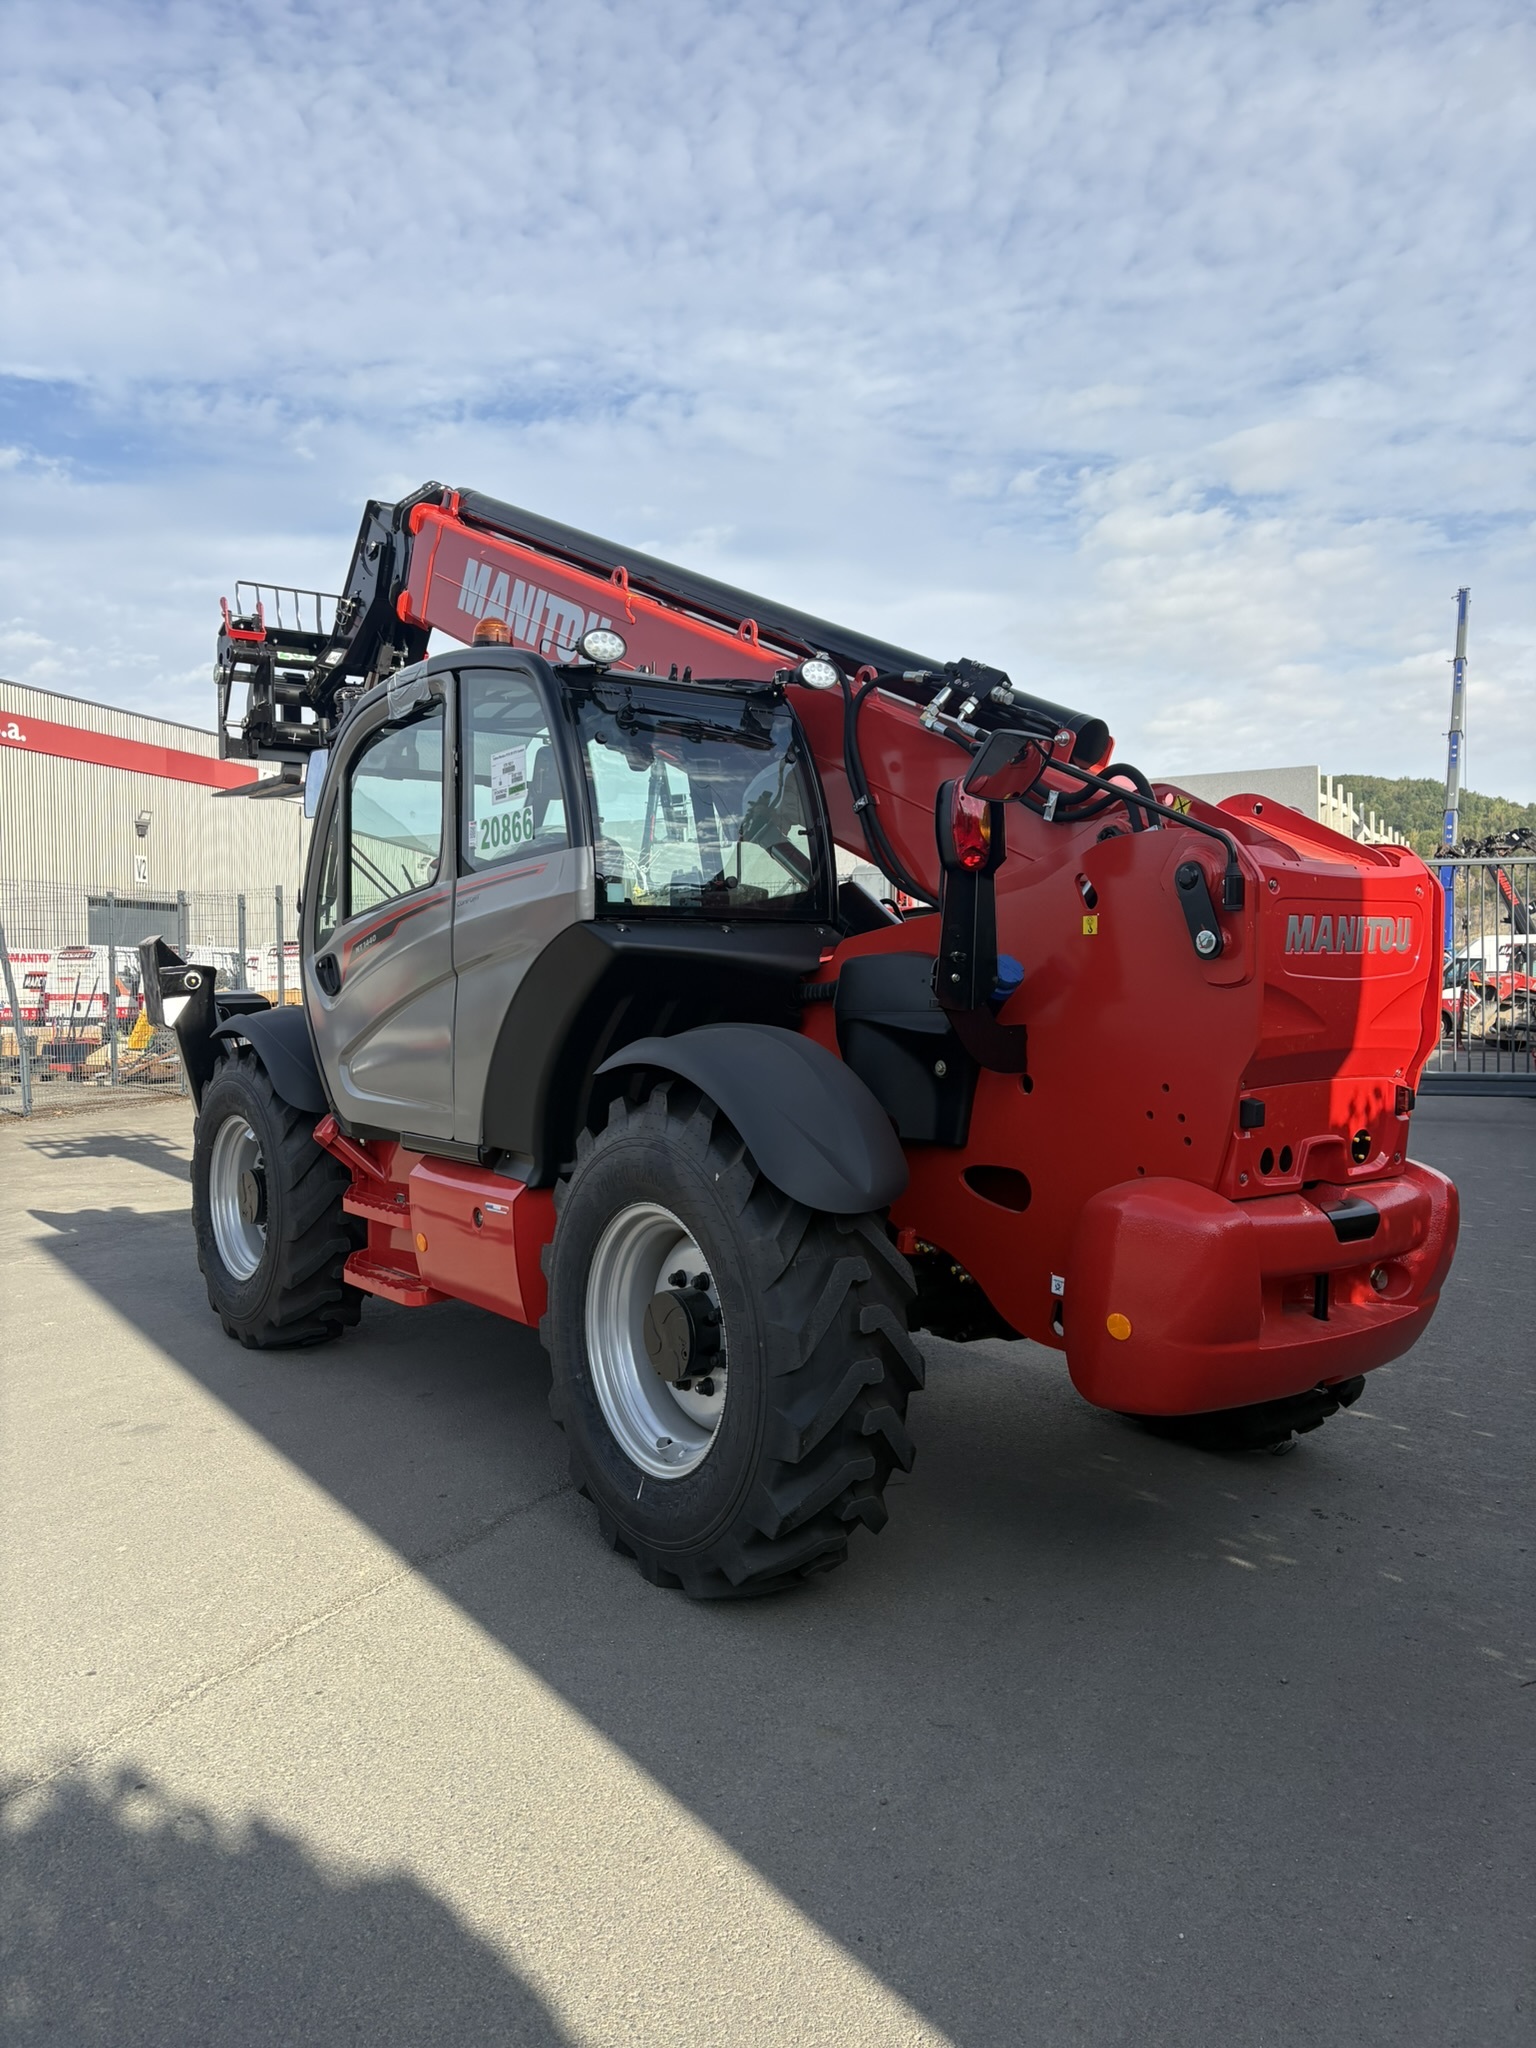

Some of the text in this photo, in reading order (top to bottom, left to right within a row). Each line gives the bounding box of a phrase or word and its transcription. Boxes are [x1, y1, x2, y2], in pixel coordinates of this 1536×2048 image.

[0, 722, 27, 742] .a.
[481, 807, 533, 850] 20866
[1284, 914, 1412, 955] MANITOU
[8, 952, 50, 963] MANITO
